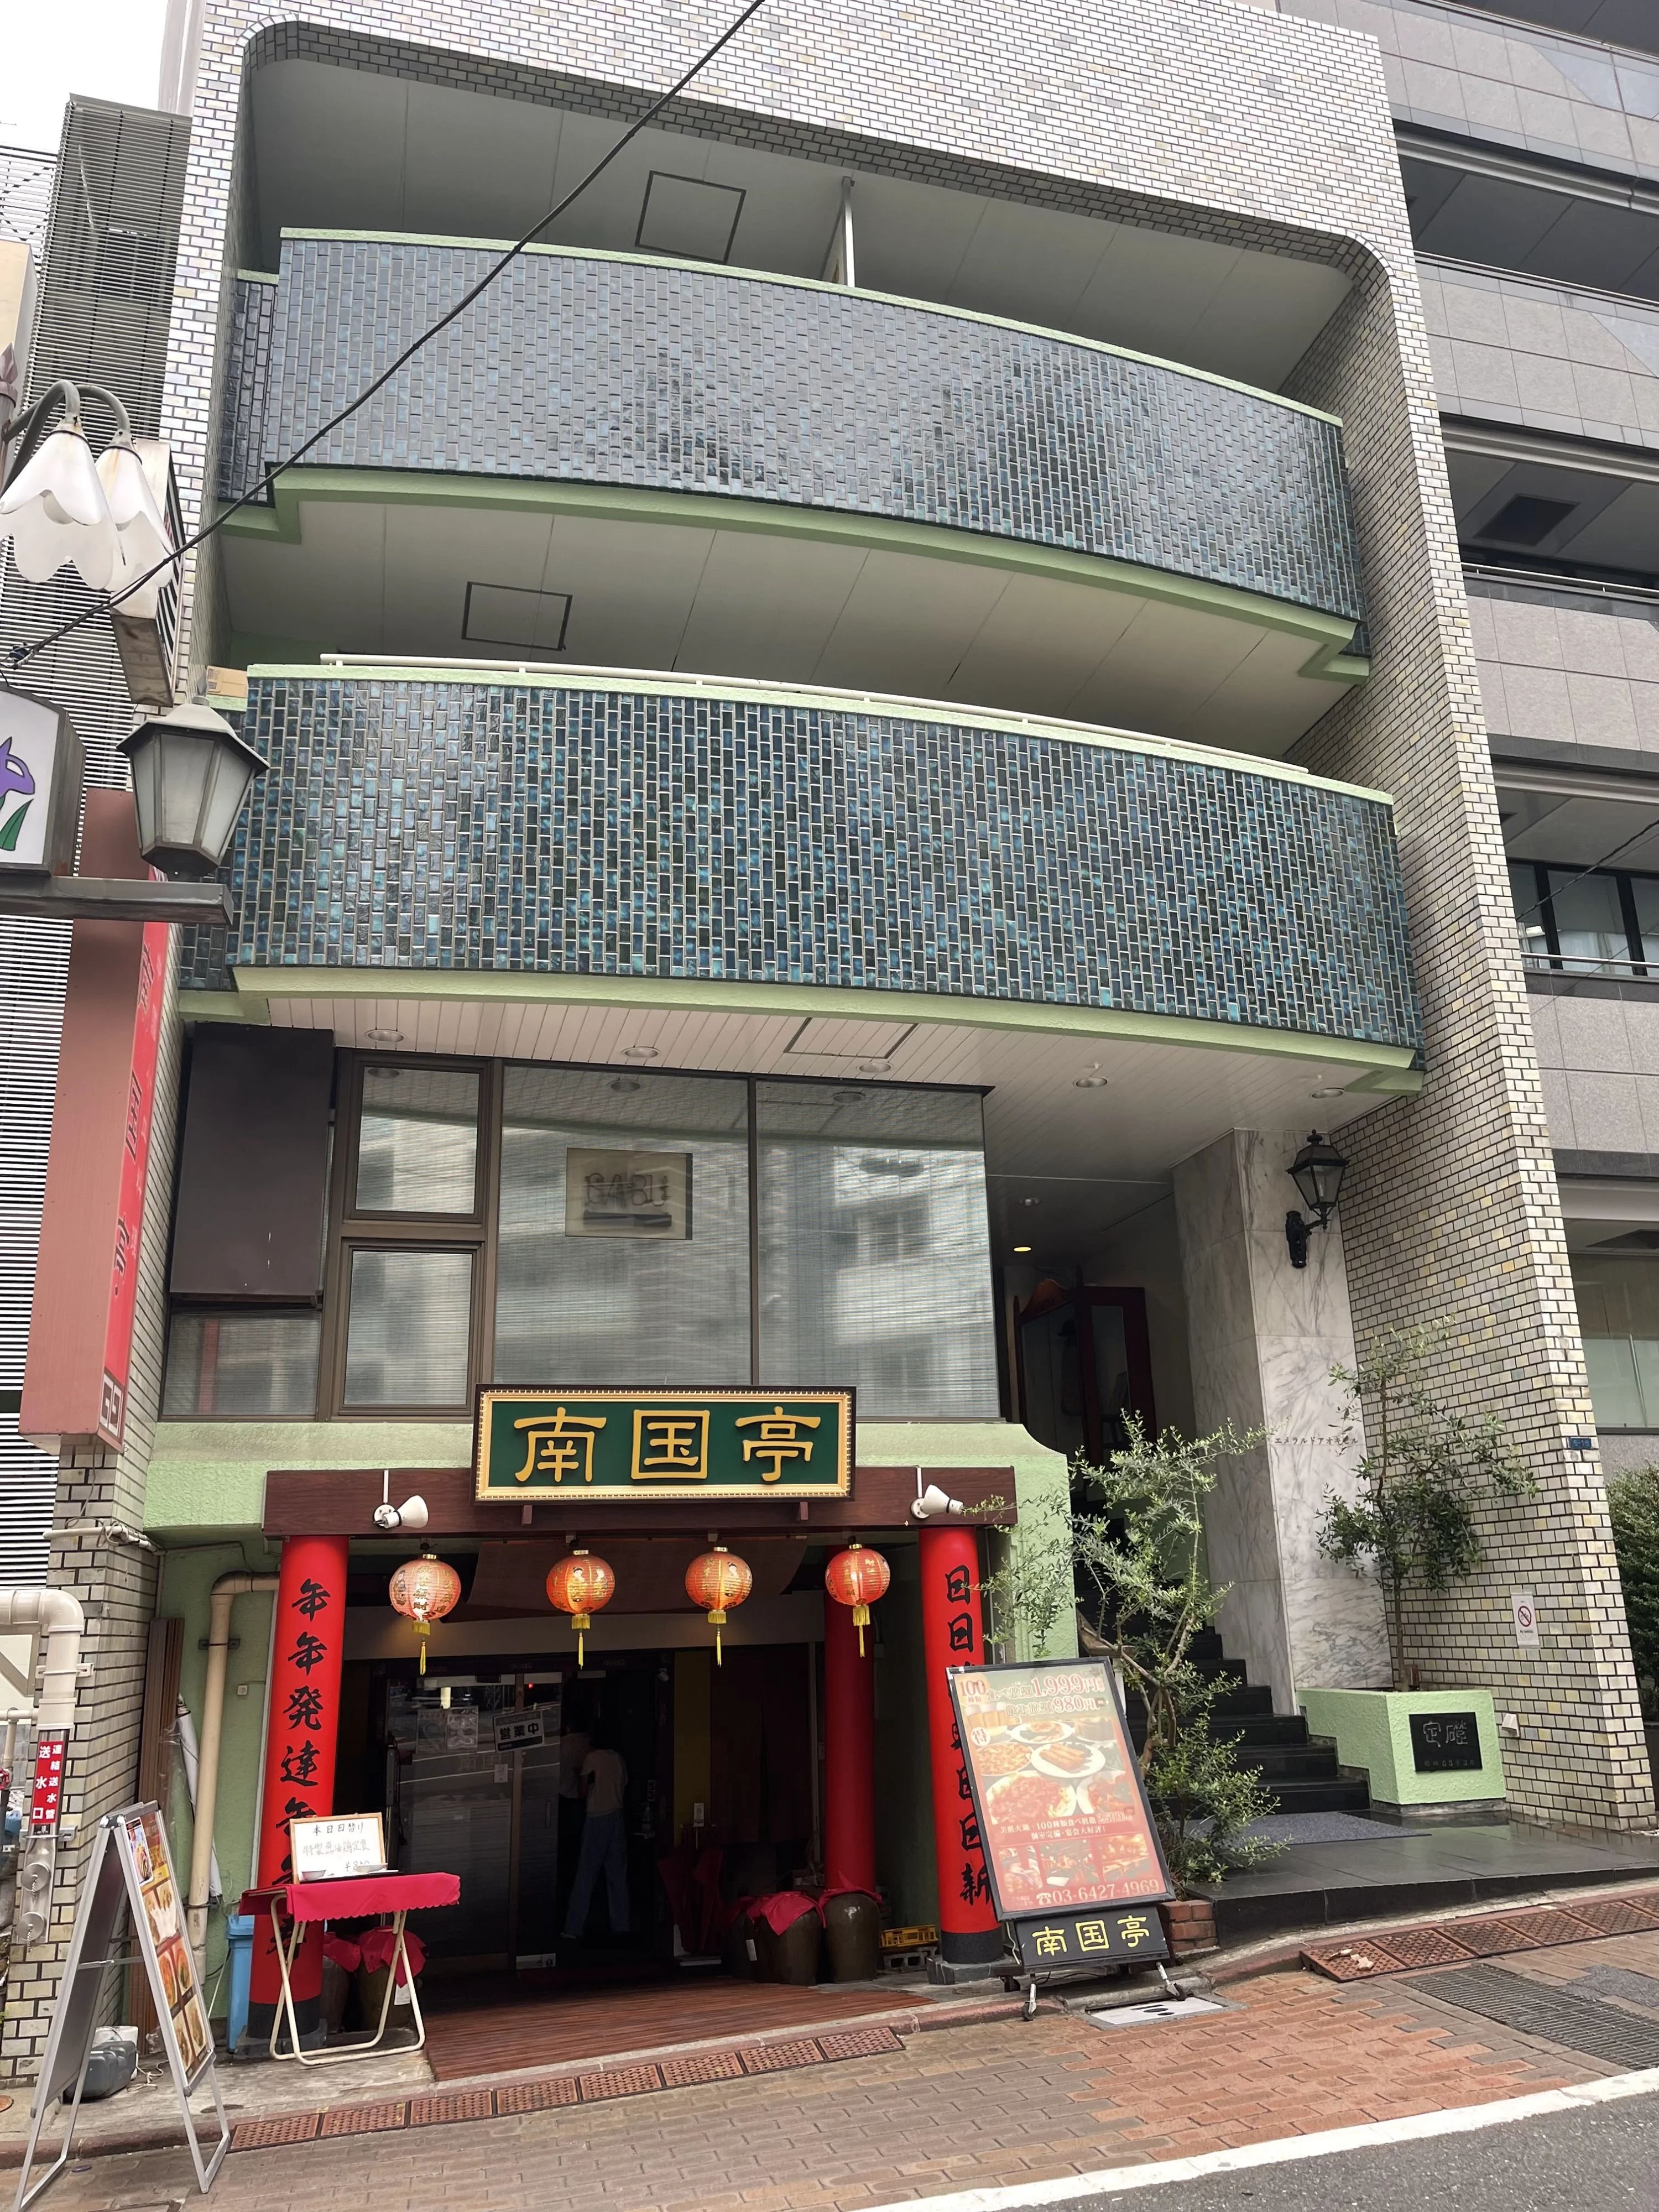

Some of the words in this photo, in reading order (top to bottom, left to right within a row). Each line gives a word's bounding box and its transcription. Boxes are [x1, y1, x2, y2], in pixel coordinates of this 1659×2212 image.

[513, 1406, 821, 1483] 南国亭
[499, 1723, 539, 1740] 営業中
[971, 1728, 988, 1745] 得
[32, 1745, 51, 1820] 送水口
[45, 1744, 62, 1820] 連結送水管
[1051, 1878, 1160, 1905] 03-6427-4969
[1031, 1914, 1150, 1957] 南国亭
